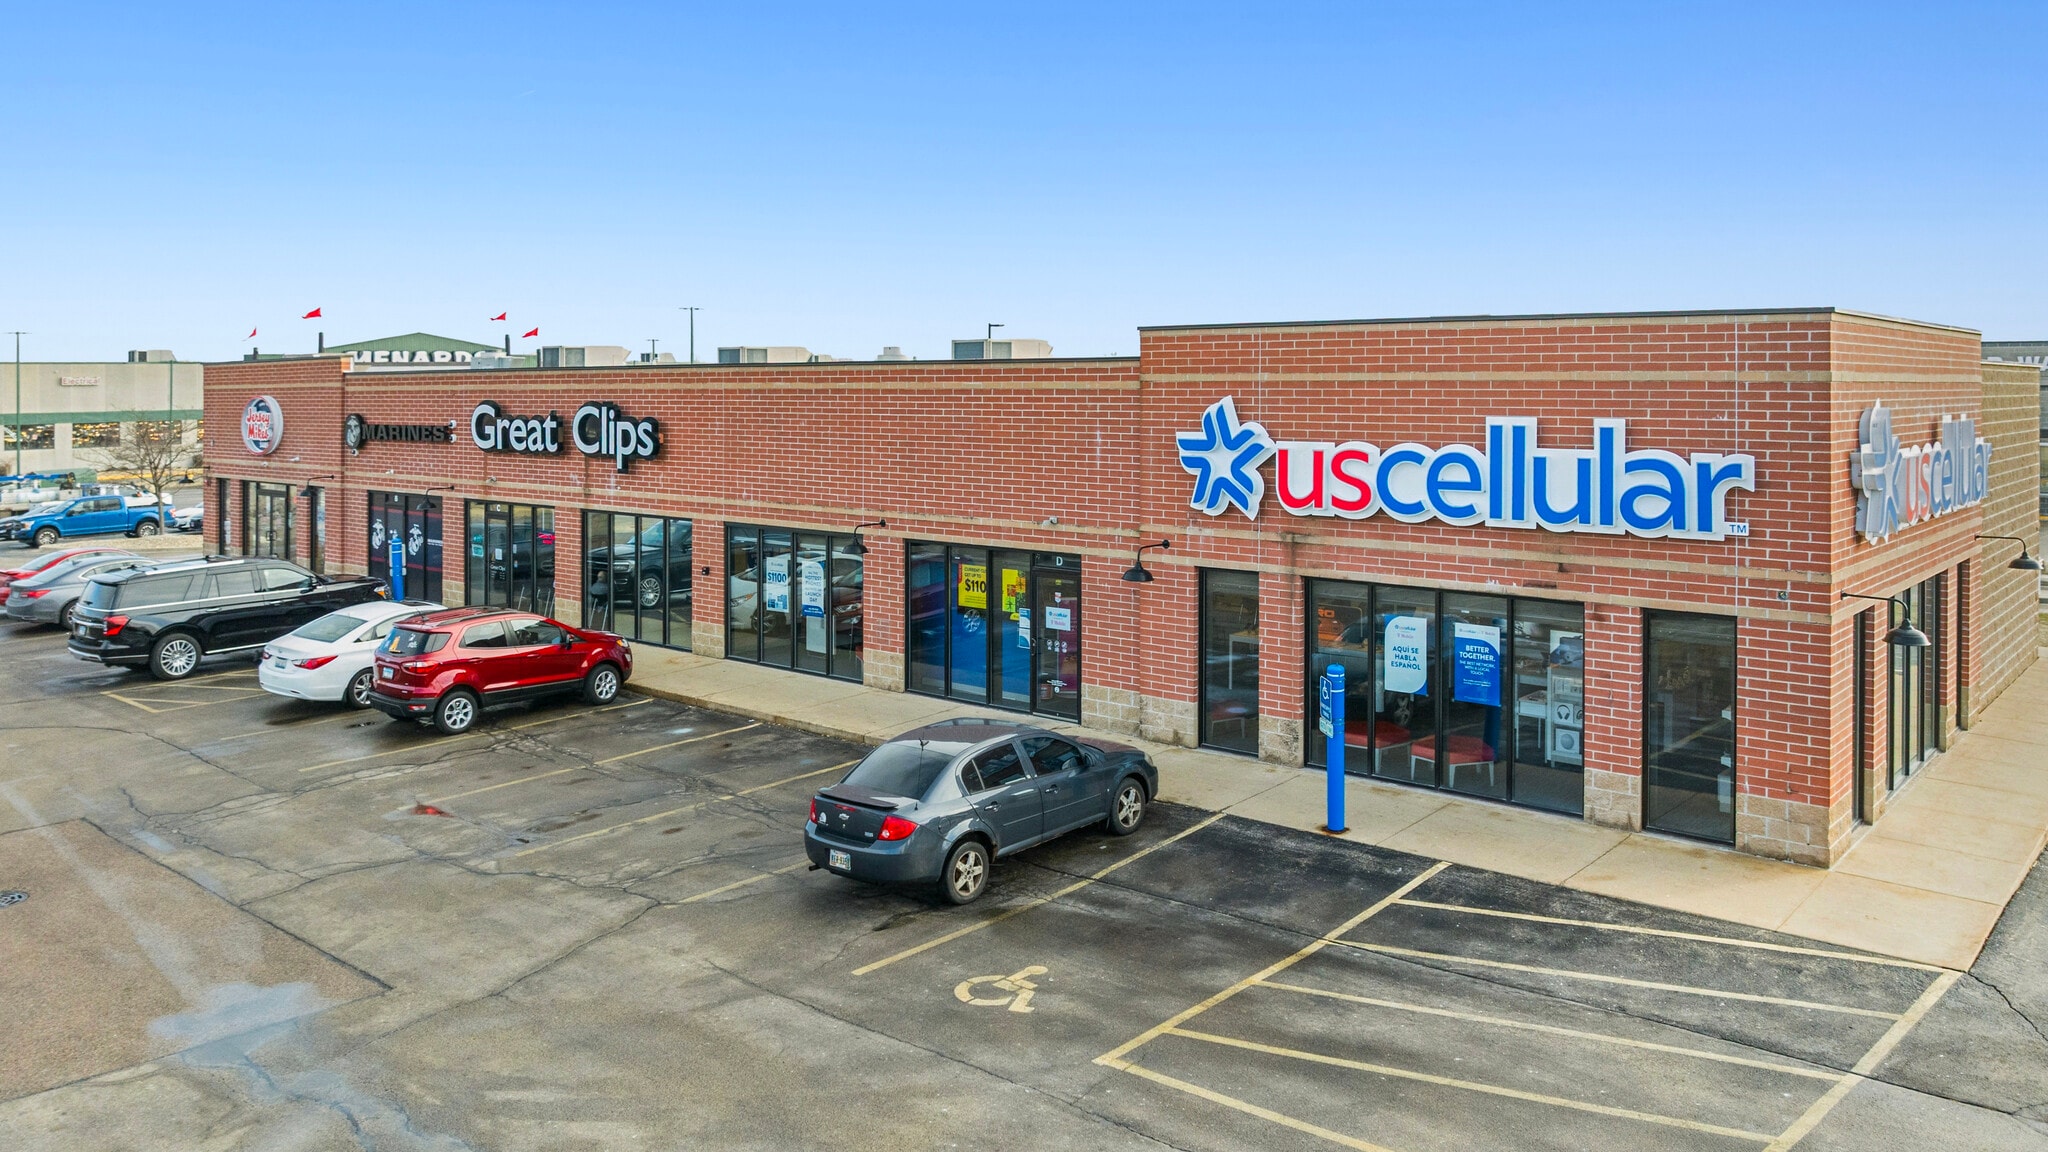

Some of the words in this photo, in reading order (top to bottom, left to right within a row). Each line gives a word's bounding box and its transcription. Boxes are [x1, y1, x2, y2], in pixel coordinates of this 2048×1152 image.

[246, 407, 270, 428] Jersey
[361, 424, 445, 442] MARINES
[471, 404, 558, 452] Great
[572, 405, 655, 469] Clips
[1277, 424, 1743, 533] uscellular
[1905, 420, 1993, 526] uscellular
[1056, 557, 1063, 566] D
[1459, 651, 1496, 662] TOGETHER.
[1465, 645, 1490, 654] BETTER
[1395, 653, 1417, 662] HABLA
[1391, 660, 1421, 671] ESPAÑOL
